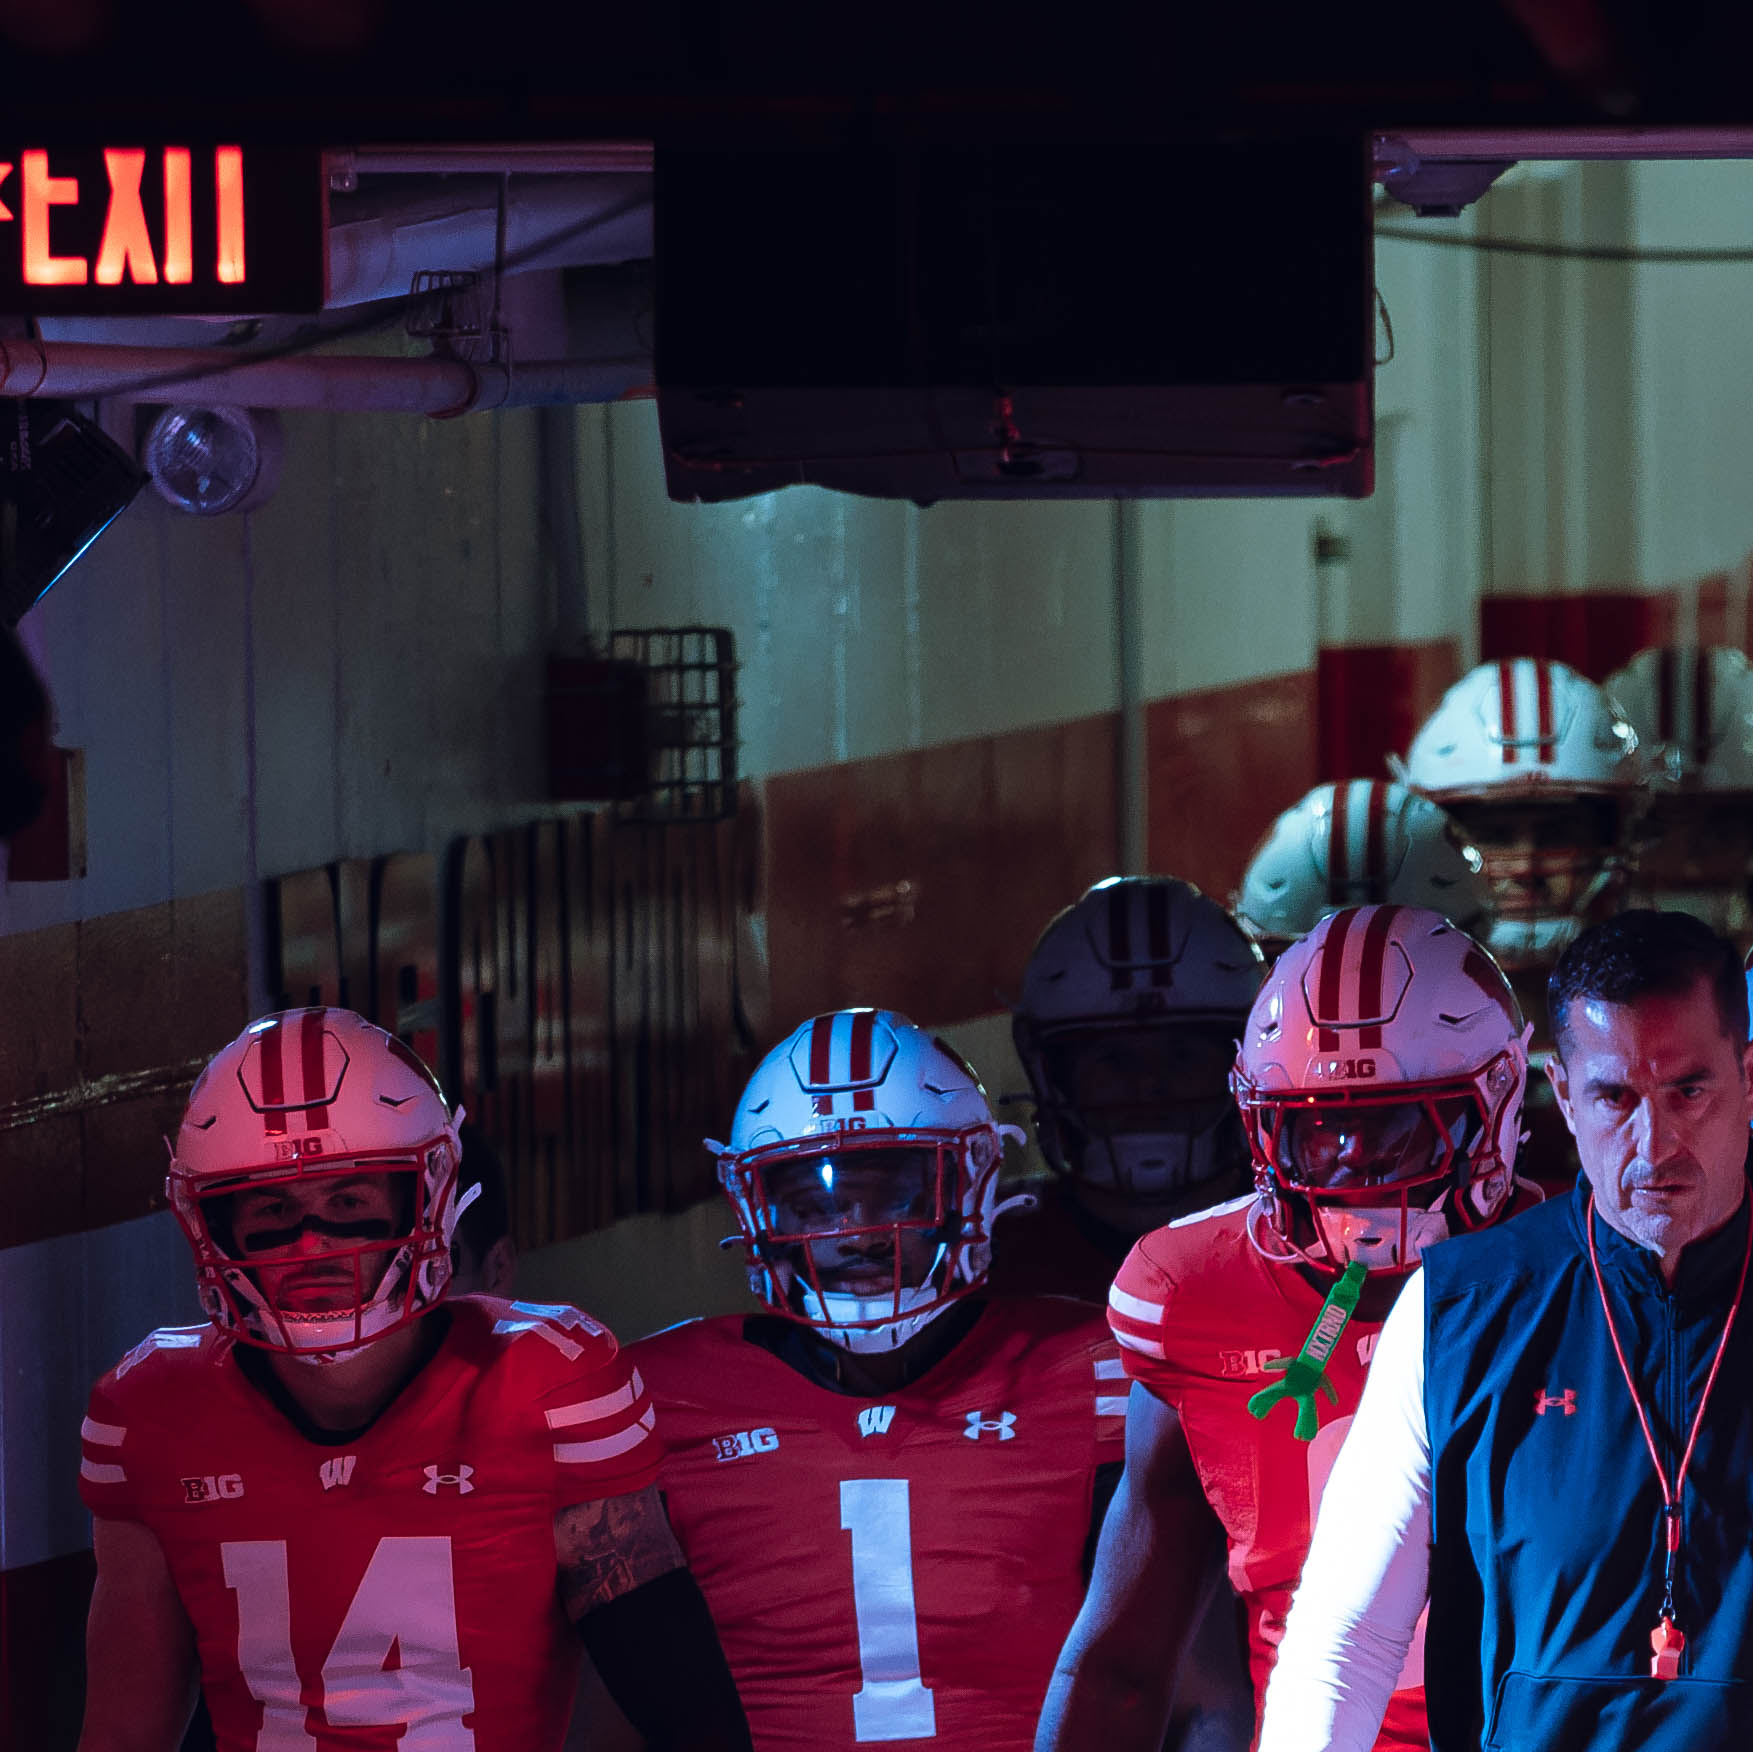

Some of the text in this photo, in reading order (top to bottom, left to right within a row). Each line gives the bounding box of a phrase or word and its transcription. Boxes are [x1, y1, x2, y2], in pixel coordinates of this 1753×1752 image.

[858, 1405, 896, 1438] W
[319, 1456, 356, 1490] W
[839, 1479, 936, 1742] 1
